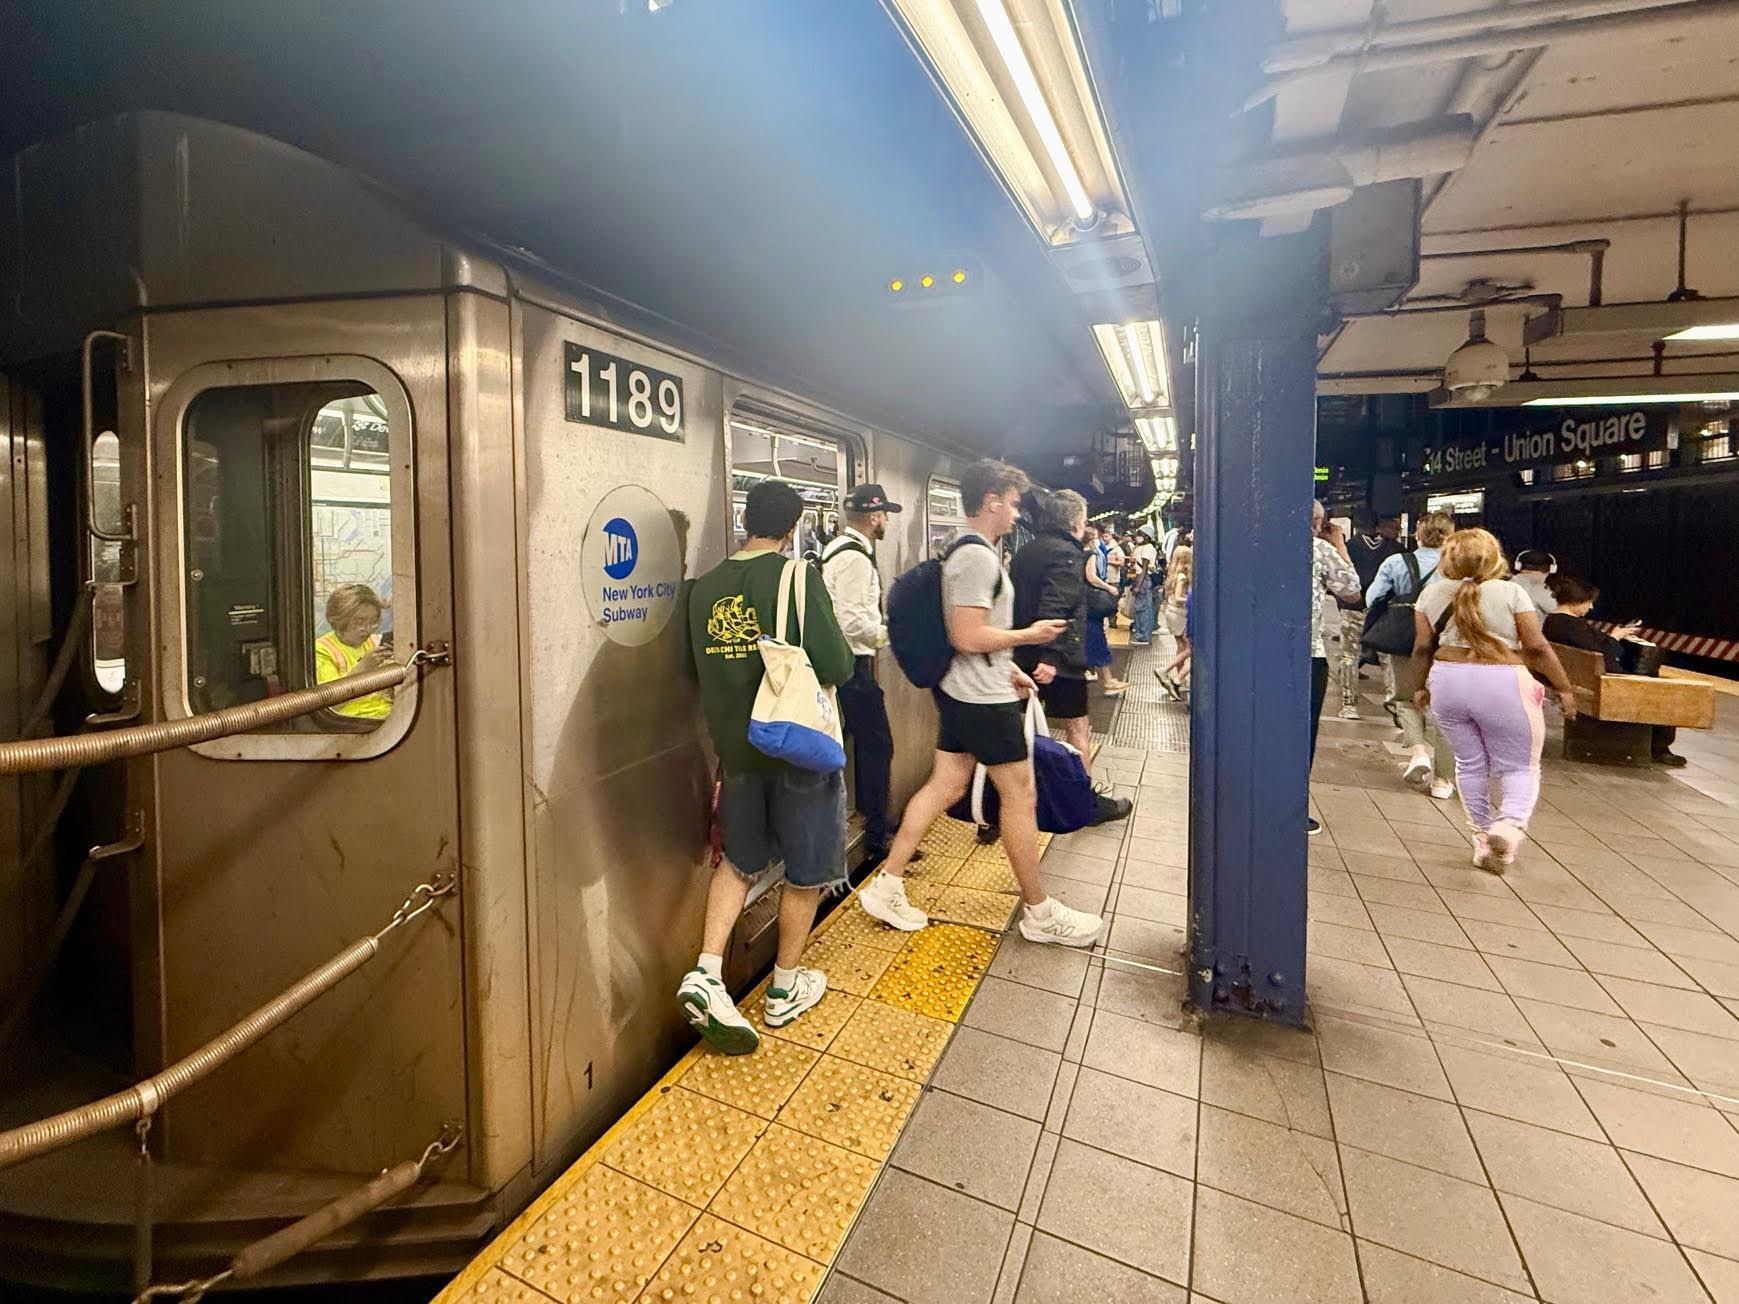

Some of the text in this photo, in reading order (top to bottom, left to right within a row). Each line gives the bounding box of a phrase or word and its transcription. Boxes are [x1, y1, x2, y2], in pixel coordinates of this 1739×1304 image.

[571, 353, 680, 434] 1189
[1445, 440, 1487, 472] Street
[1504, 430, 1554, 463] Union
[1561, 411, 1647, 456] Square
[601, 530, 634, 568] MTA
[603, 582, 677, 601] New York City
[603, 606, 648, 623] Subway
[583, 1060, 593, 1090] 1
